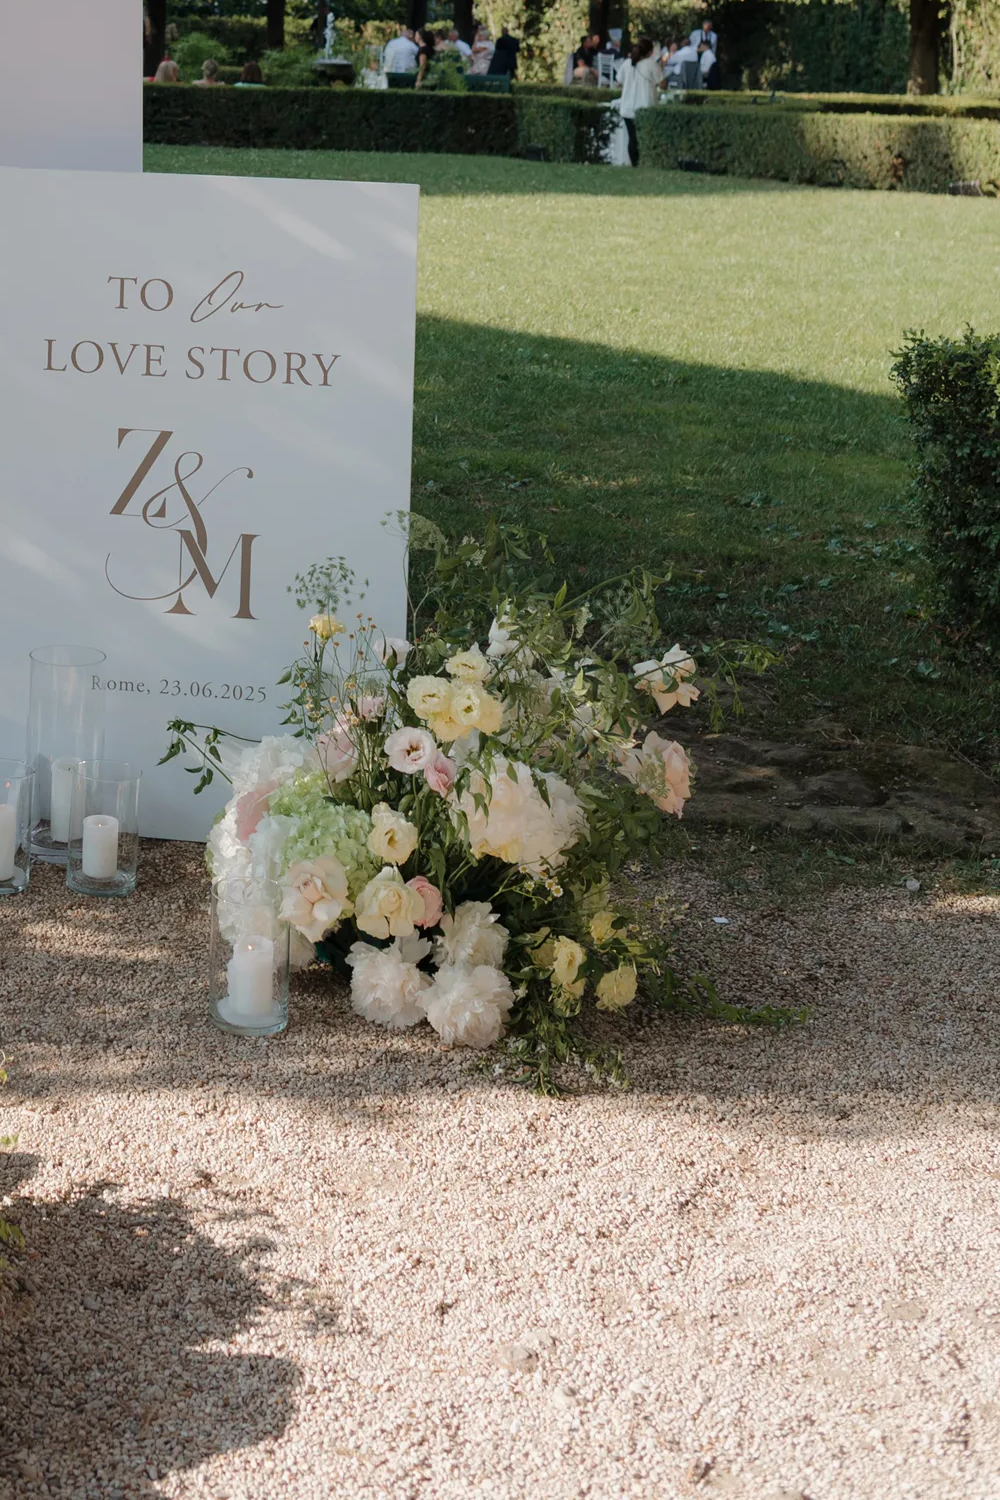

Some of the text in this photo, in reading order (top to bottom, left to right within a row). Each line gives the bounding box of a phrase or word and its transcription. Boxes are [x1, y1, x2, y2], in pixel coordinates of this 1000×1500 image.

[107, 270, 284, 323] TO Our
[43, 338, 342, 387] LOVE STORY
[91, 674, 267, 703] Rome, 23.06.2025
